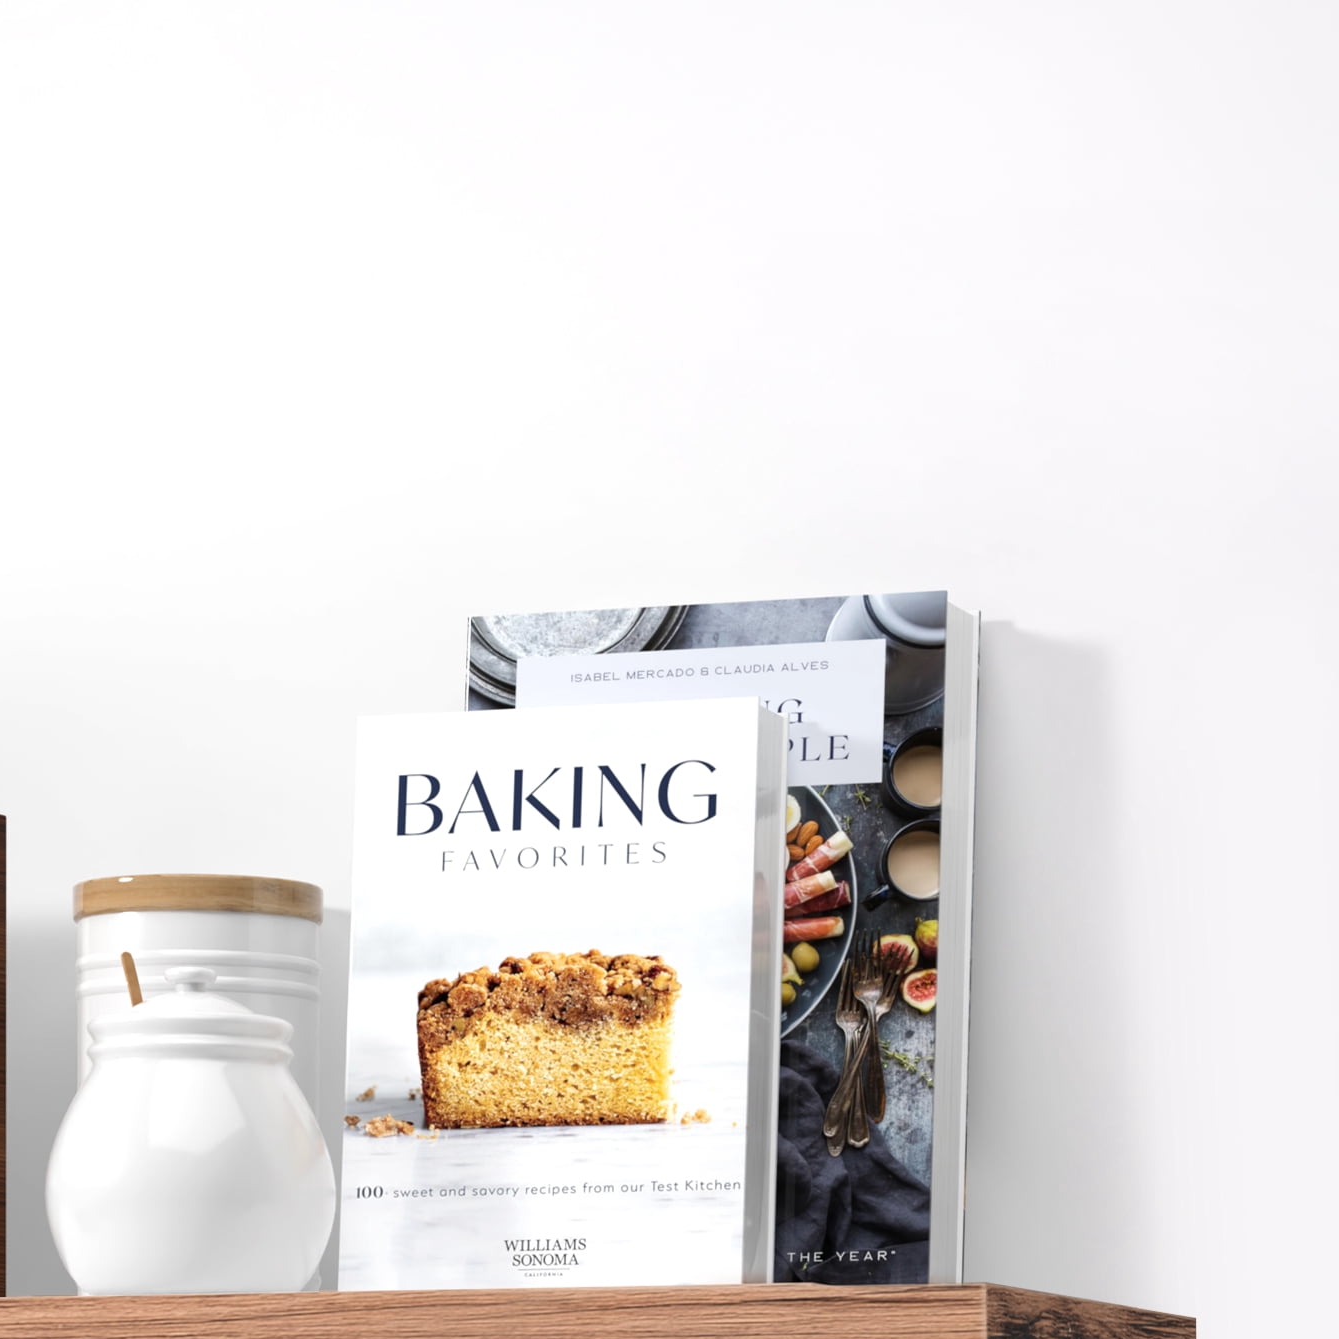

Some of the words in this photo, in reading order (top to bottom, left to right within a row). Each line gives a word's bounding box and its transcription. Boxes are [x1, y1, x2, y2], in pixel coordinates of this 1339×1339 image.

[570, 671, 620, 683] ISABEL
[626, 667, 694, 680] MERCADO
[714, 662, 774, 676] CLAUDIA
[781, 660, 830, 672] ALVES
[396, 759, 718, 836] BAKING
[441, 841, 667, 872] FAVORITES
[393, 1187, 433, 1199] sweet
[439, 1185, 466, 1198] and
[472, 1186, 520, 1198] savory
[525, 1183, 577, 1196] recipes
[582, 1182, 614, 1193] from
[620, 1183, 644, 1193] our
[650, 1180, 679, 1192] Test
[685, 1179, 741, 1192] Kitchen
[504, 1238, 587, 1252] WILLIAMS
[511, 1253, 579, 1267] SONOMA
[787, 1251, 823, 1263] THE
